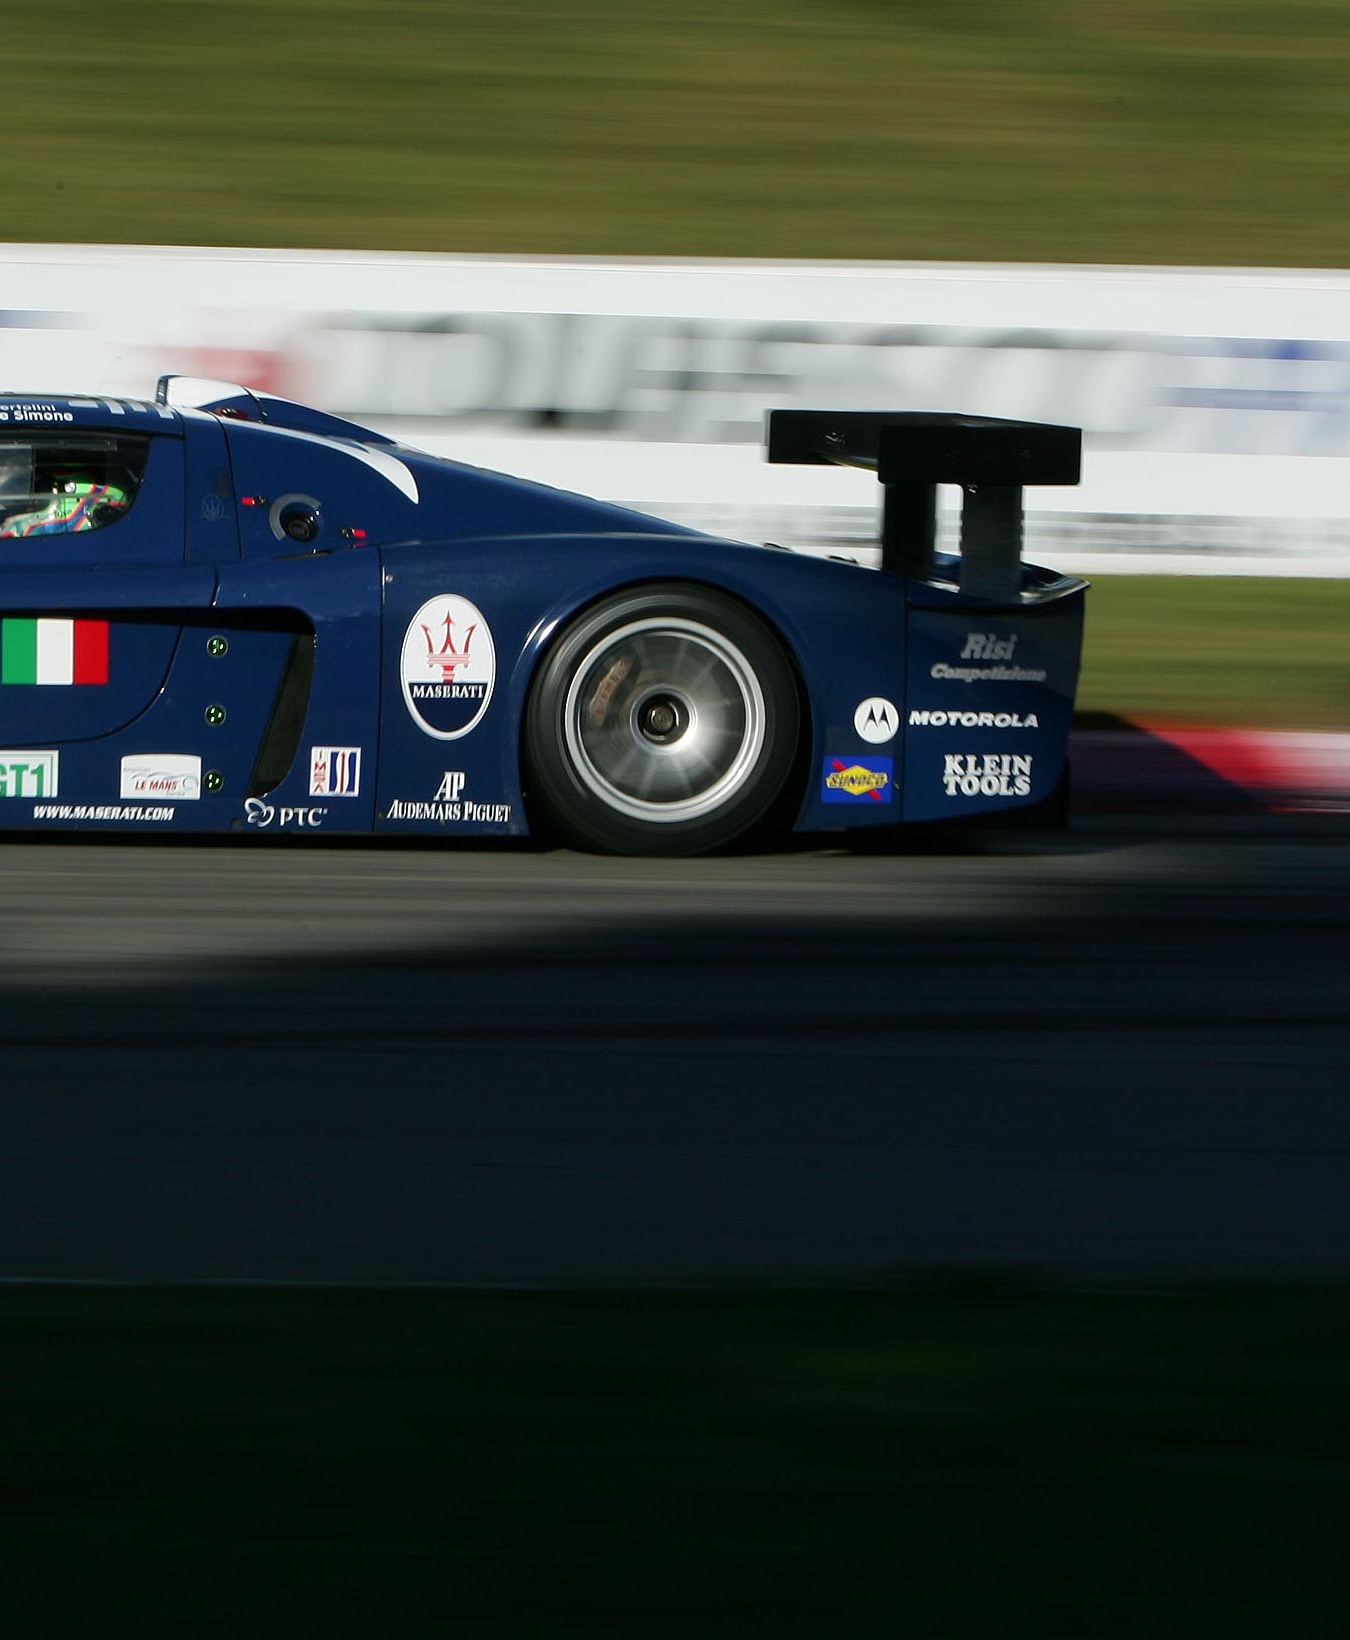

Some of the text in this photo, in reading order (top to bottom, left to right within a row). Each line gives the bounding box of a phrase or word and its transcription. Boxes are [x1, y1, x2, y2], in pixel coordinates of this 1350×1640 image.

[13, 410, 74, 421] Simone
[960, 632, 1017, 660] Risi
[412, 684, 484, 698] MASERATI
[908, 710, 1039, 728] MOTOROLA
[943, 754, 1033, 777] KLEIN
[433, 771, 465, 801] AP
[942, 775, 1031, 796] TOOLS
[33, 805, 175, 821] WWW.MASERATI.COM
[279, 807, 323, 826] PTC
[386, 799, 511, 822] AUDEMARS PIGUET
